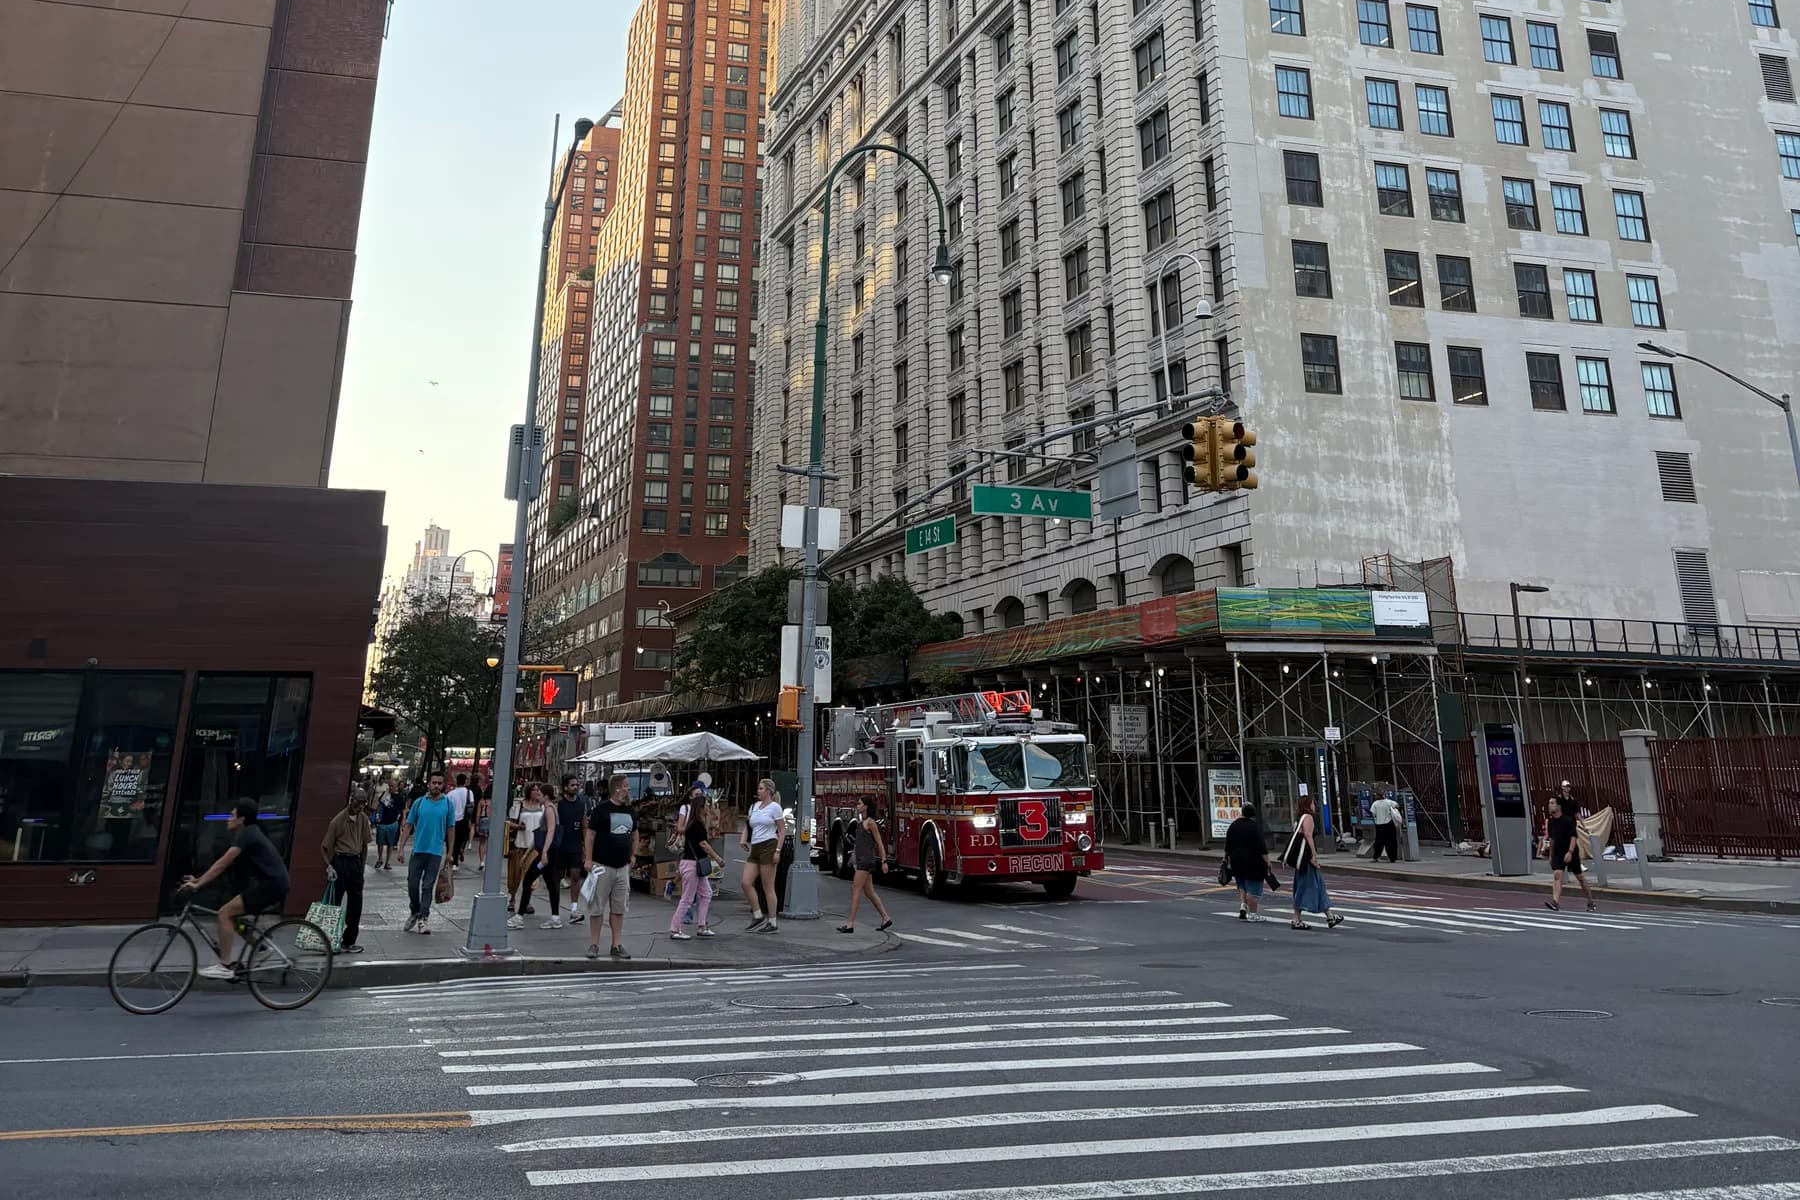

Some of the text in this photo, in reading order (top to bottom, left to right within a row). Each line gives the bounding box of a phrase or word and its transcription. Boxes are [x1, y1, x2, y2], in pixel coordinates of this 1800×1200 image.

[1010, 492, 1058, 512] 3 Av
[919, 526, 940, 547] E 14 St
[111, 782, 138, 790] HOURS
[113, 774, 140, 782] LUNCH
[1018, 800, 1048, 841] 3
[970, 834, 998, 847] F.D.
[1008, 853, 1065, 873] RECON
